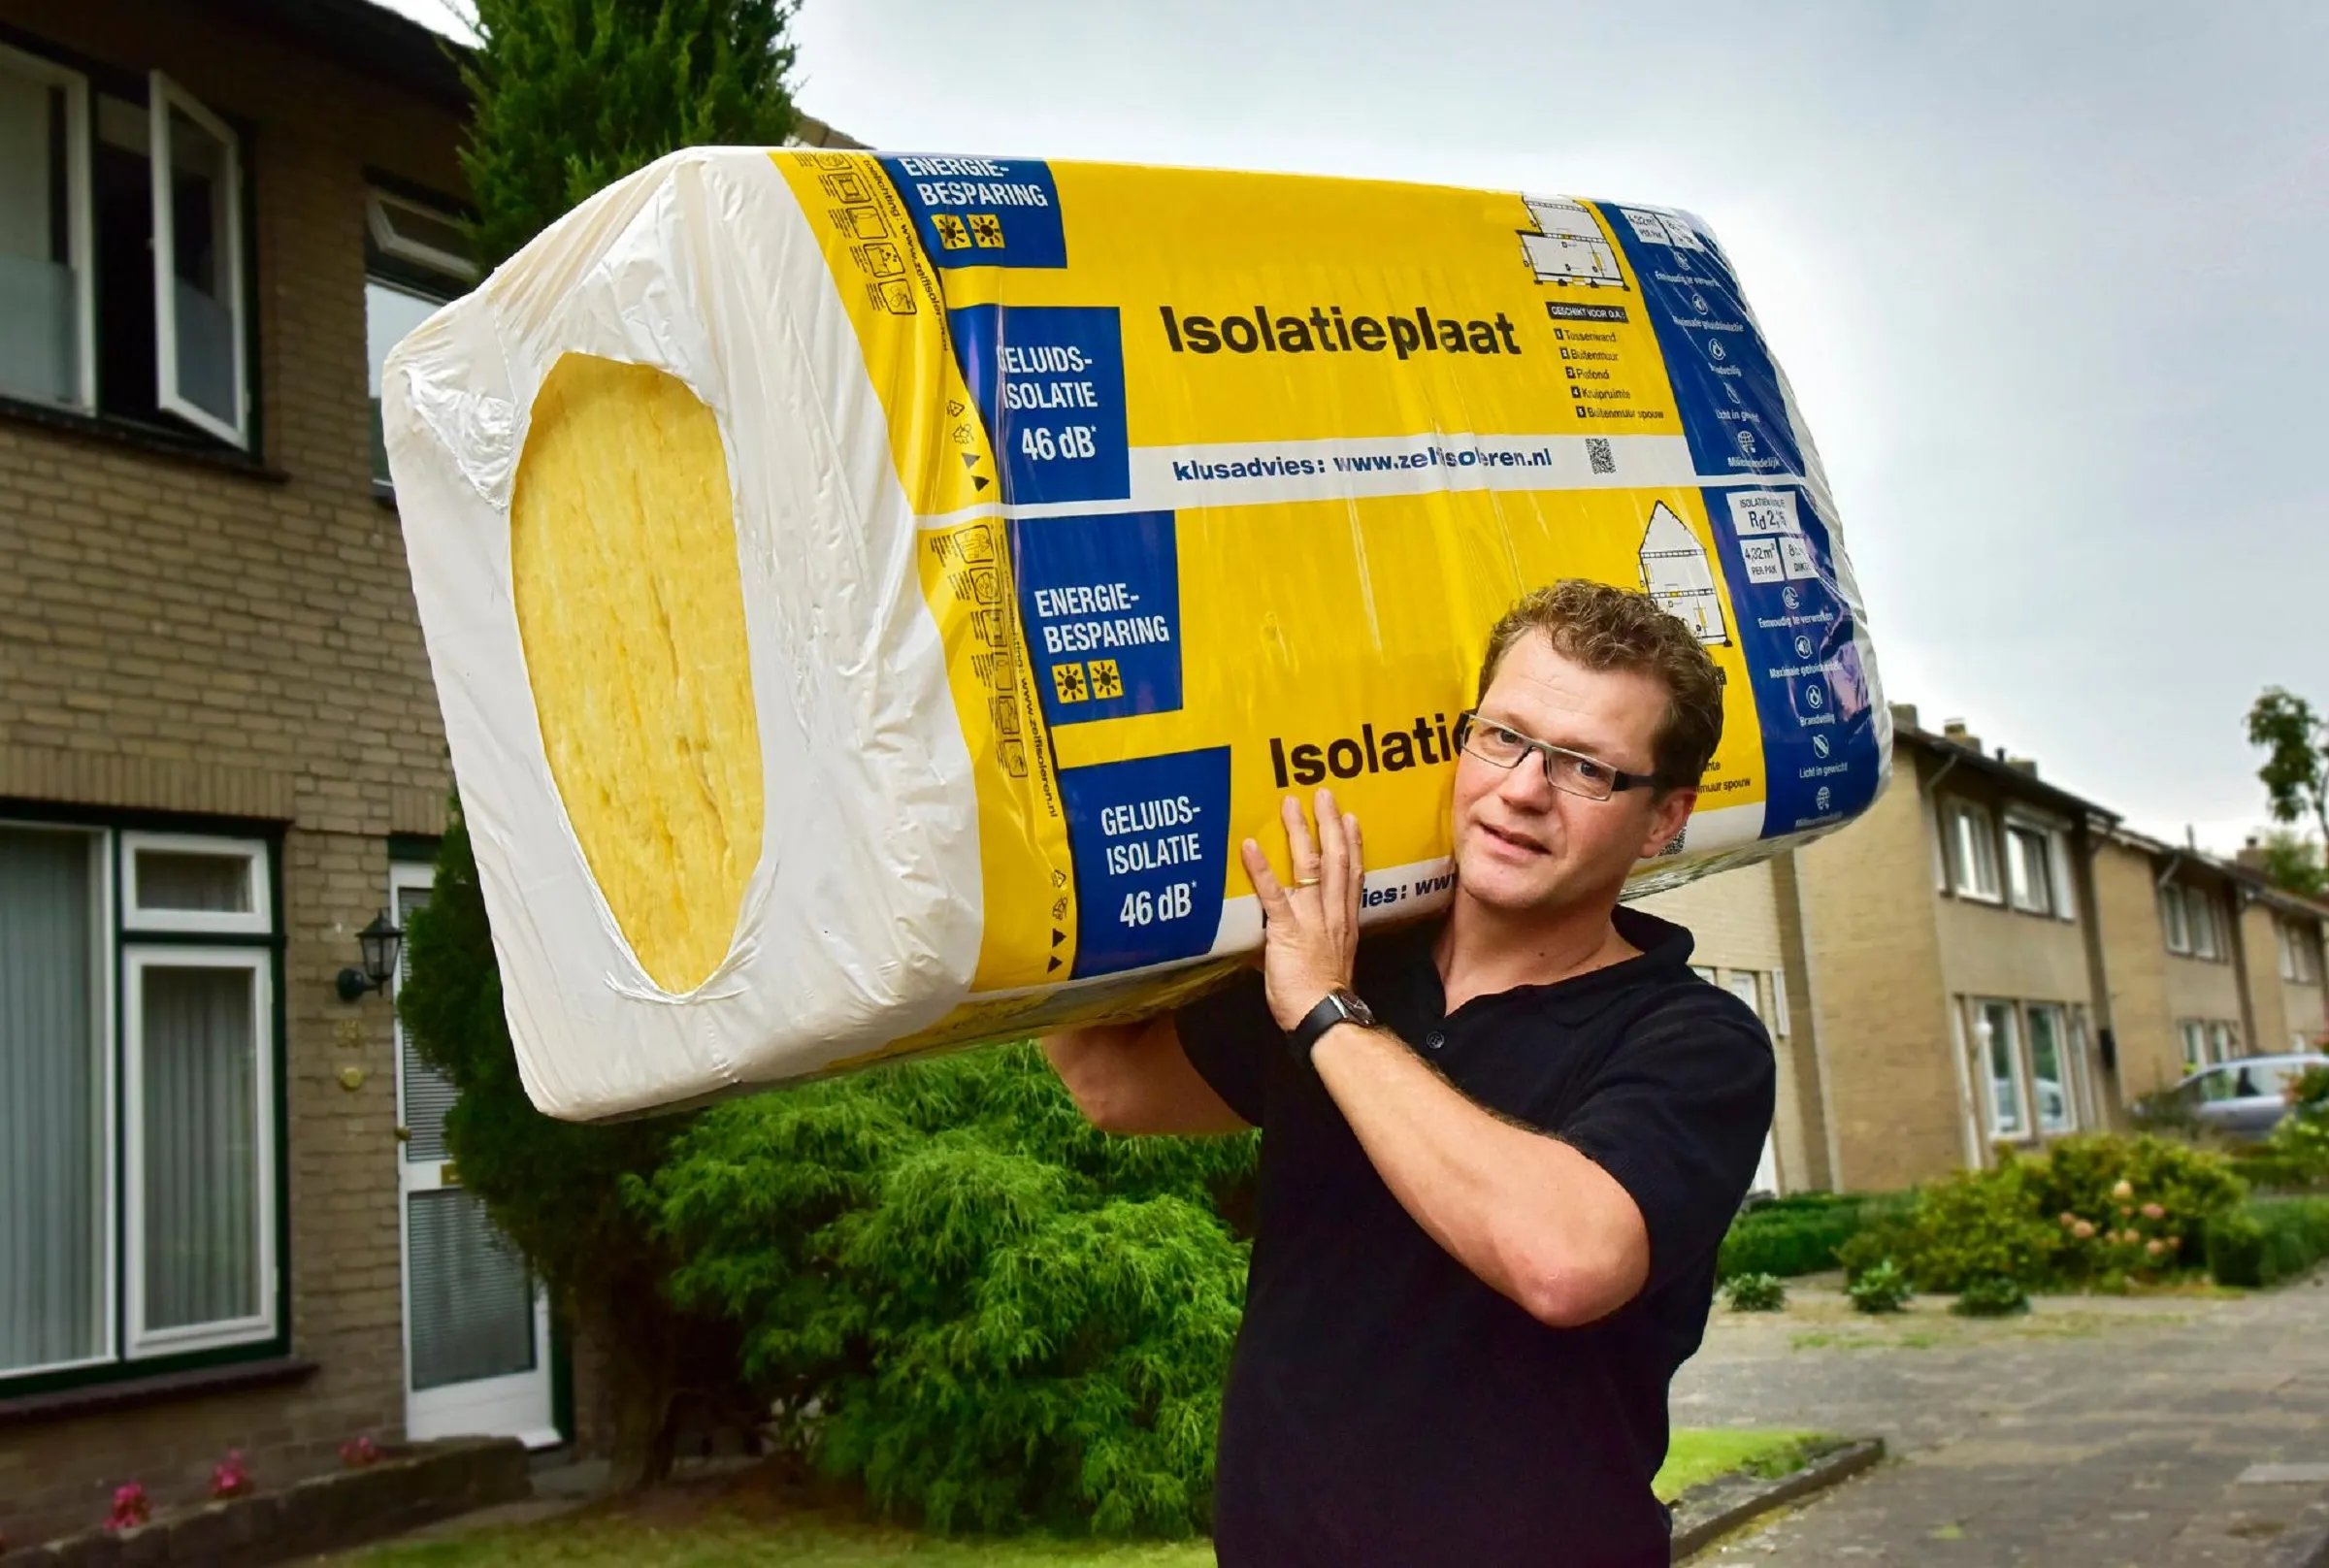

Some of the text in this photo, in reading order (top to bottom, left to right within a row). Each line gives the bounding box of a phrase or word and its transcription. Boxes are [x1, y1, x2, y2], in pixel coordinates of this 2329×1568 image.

[898, 157, 1009, 178] ENERGIE-
[916, 182, 1048, 208] BESPARING
[1587, 308, 1607, 318] VOOR
[1160, 306, 1522, 360] Isolatieplaat
[1564, 329, 1617, 342] Tussenwand
[1022, 427, 1056, 461] 46
[1172, 456, 1326, 481] klusadvies:
[1034, 583, 1139, 618] ENERGIE-
[1043, 615, 1169, 654] BESPARING
[1723, 777, 1751, 792] spouw
[1100, 796, 1201, 835] GELUIDS-
[1106, 833, 1202, 875] ISOLATIE
[1120, 891, 1153, 928] 46
